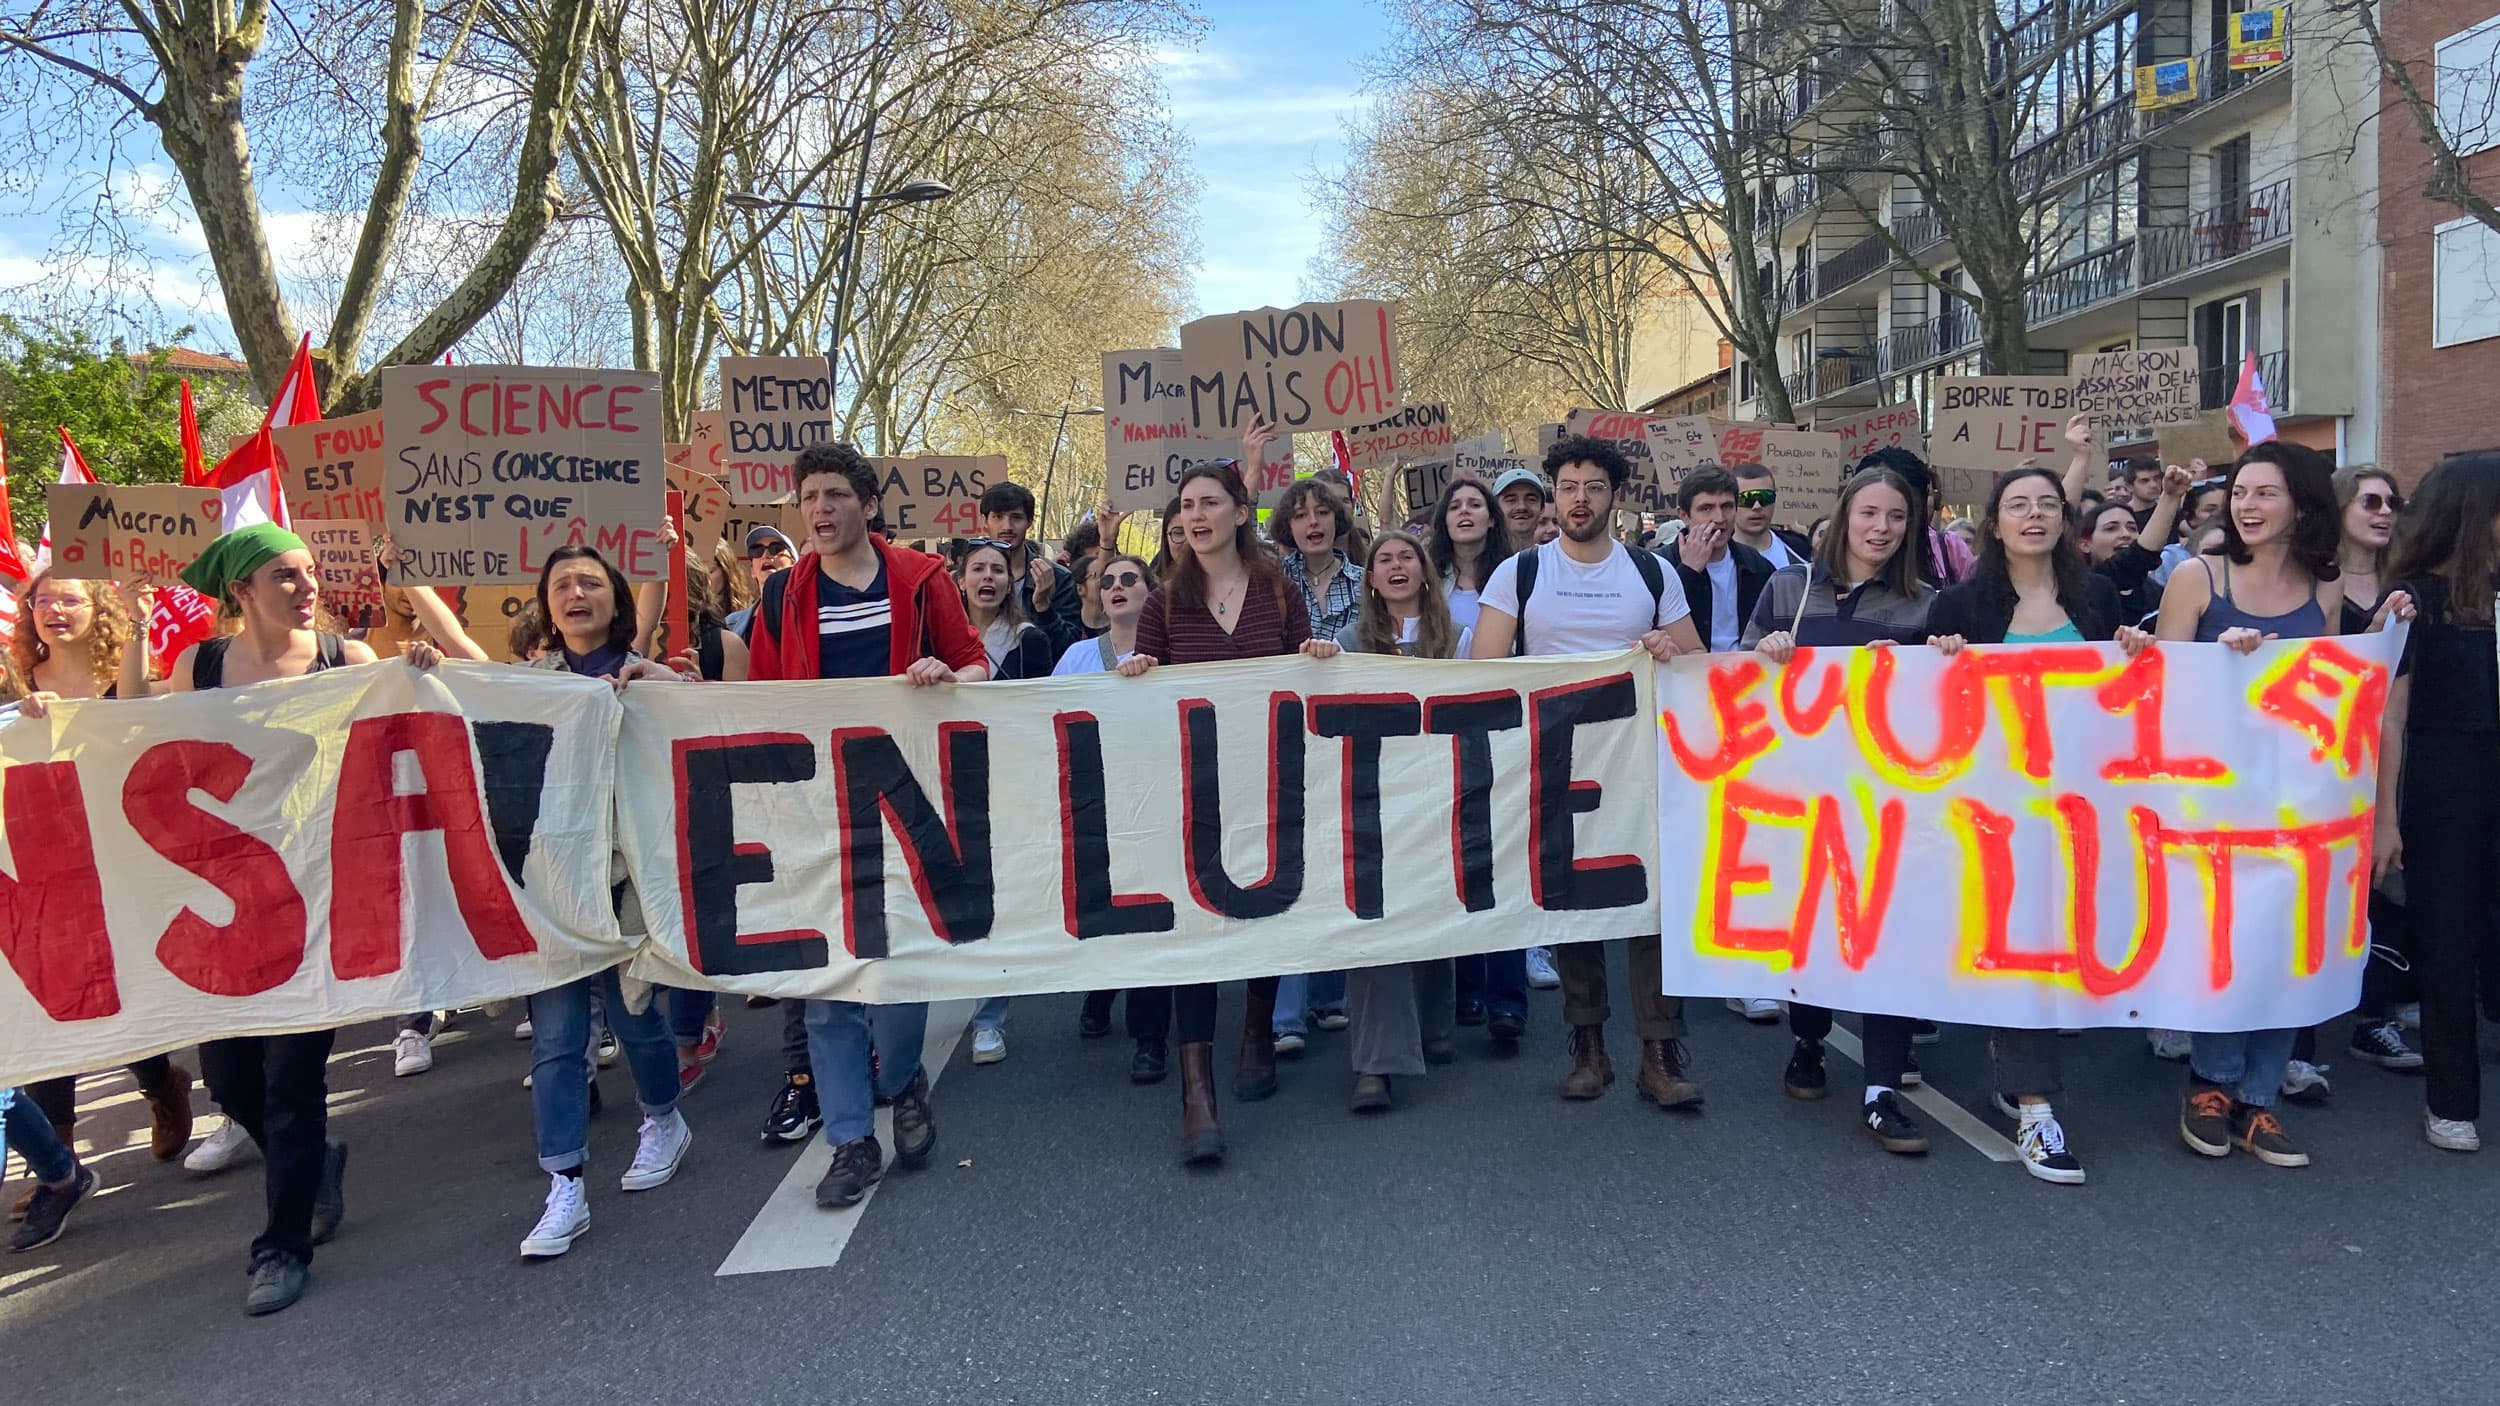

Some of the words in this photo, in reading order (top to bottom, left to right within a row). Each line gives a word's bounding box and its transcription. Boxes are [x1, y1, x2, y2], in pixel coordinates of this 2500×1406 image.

[1243, 309, 1345, 360] NON
[1324, 306, 1395, 417] OH!
[2091, 350, 2180, 376] MACRON
[732, 375, 830, 414] METRO
[1941, 386, 2015, 410] BORNE
[2075, 374, 2150, 398] ASSASSIN
[2158, 371, 2180, 388] DE
[2183, 367, 2199, 384] LA
[729, 420, 833, 453] BOULOT
[1685, 431, 1703, 442] 64
[1864, 409, 1918, 434] REPAS
[1952, 421, 1970, 442] A
[314, 419, 384, 459] FOUL
[304, 461, 354, 491] EST
[395, 446, 482, 495] SANS
[492, 449, 641, 484] CONSCIENCE
[728, 460, 797, 495] TOM
[880, 466, 910, 497] A
[923, 468, 987, 500] BAS
[1125, 464, 1155, 490] EH
[79, 495, 197, 537] Macron
[404, 492, 495, 524] N'EST
[504, 494, 573, 519] QUE
[62, 537, 89, 563] à
[102, 536, 125, 568] la
[311, 529, 361, 545] CETTE
[319, 550, 372, 564] FOULE
[398, 547, 476, 582] RUINE
[484, 550, 509, 577] DE
[325, 569, 353, 583] EST
[1848, 645, 2234, 791] UT1
[672, 720, 996, 976] EN
[1052, 671, 1649, 940] LUTTE
[1695, 778, 1907, 974] EN
